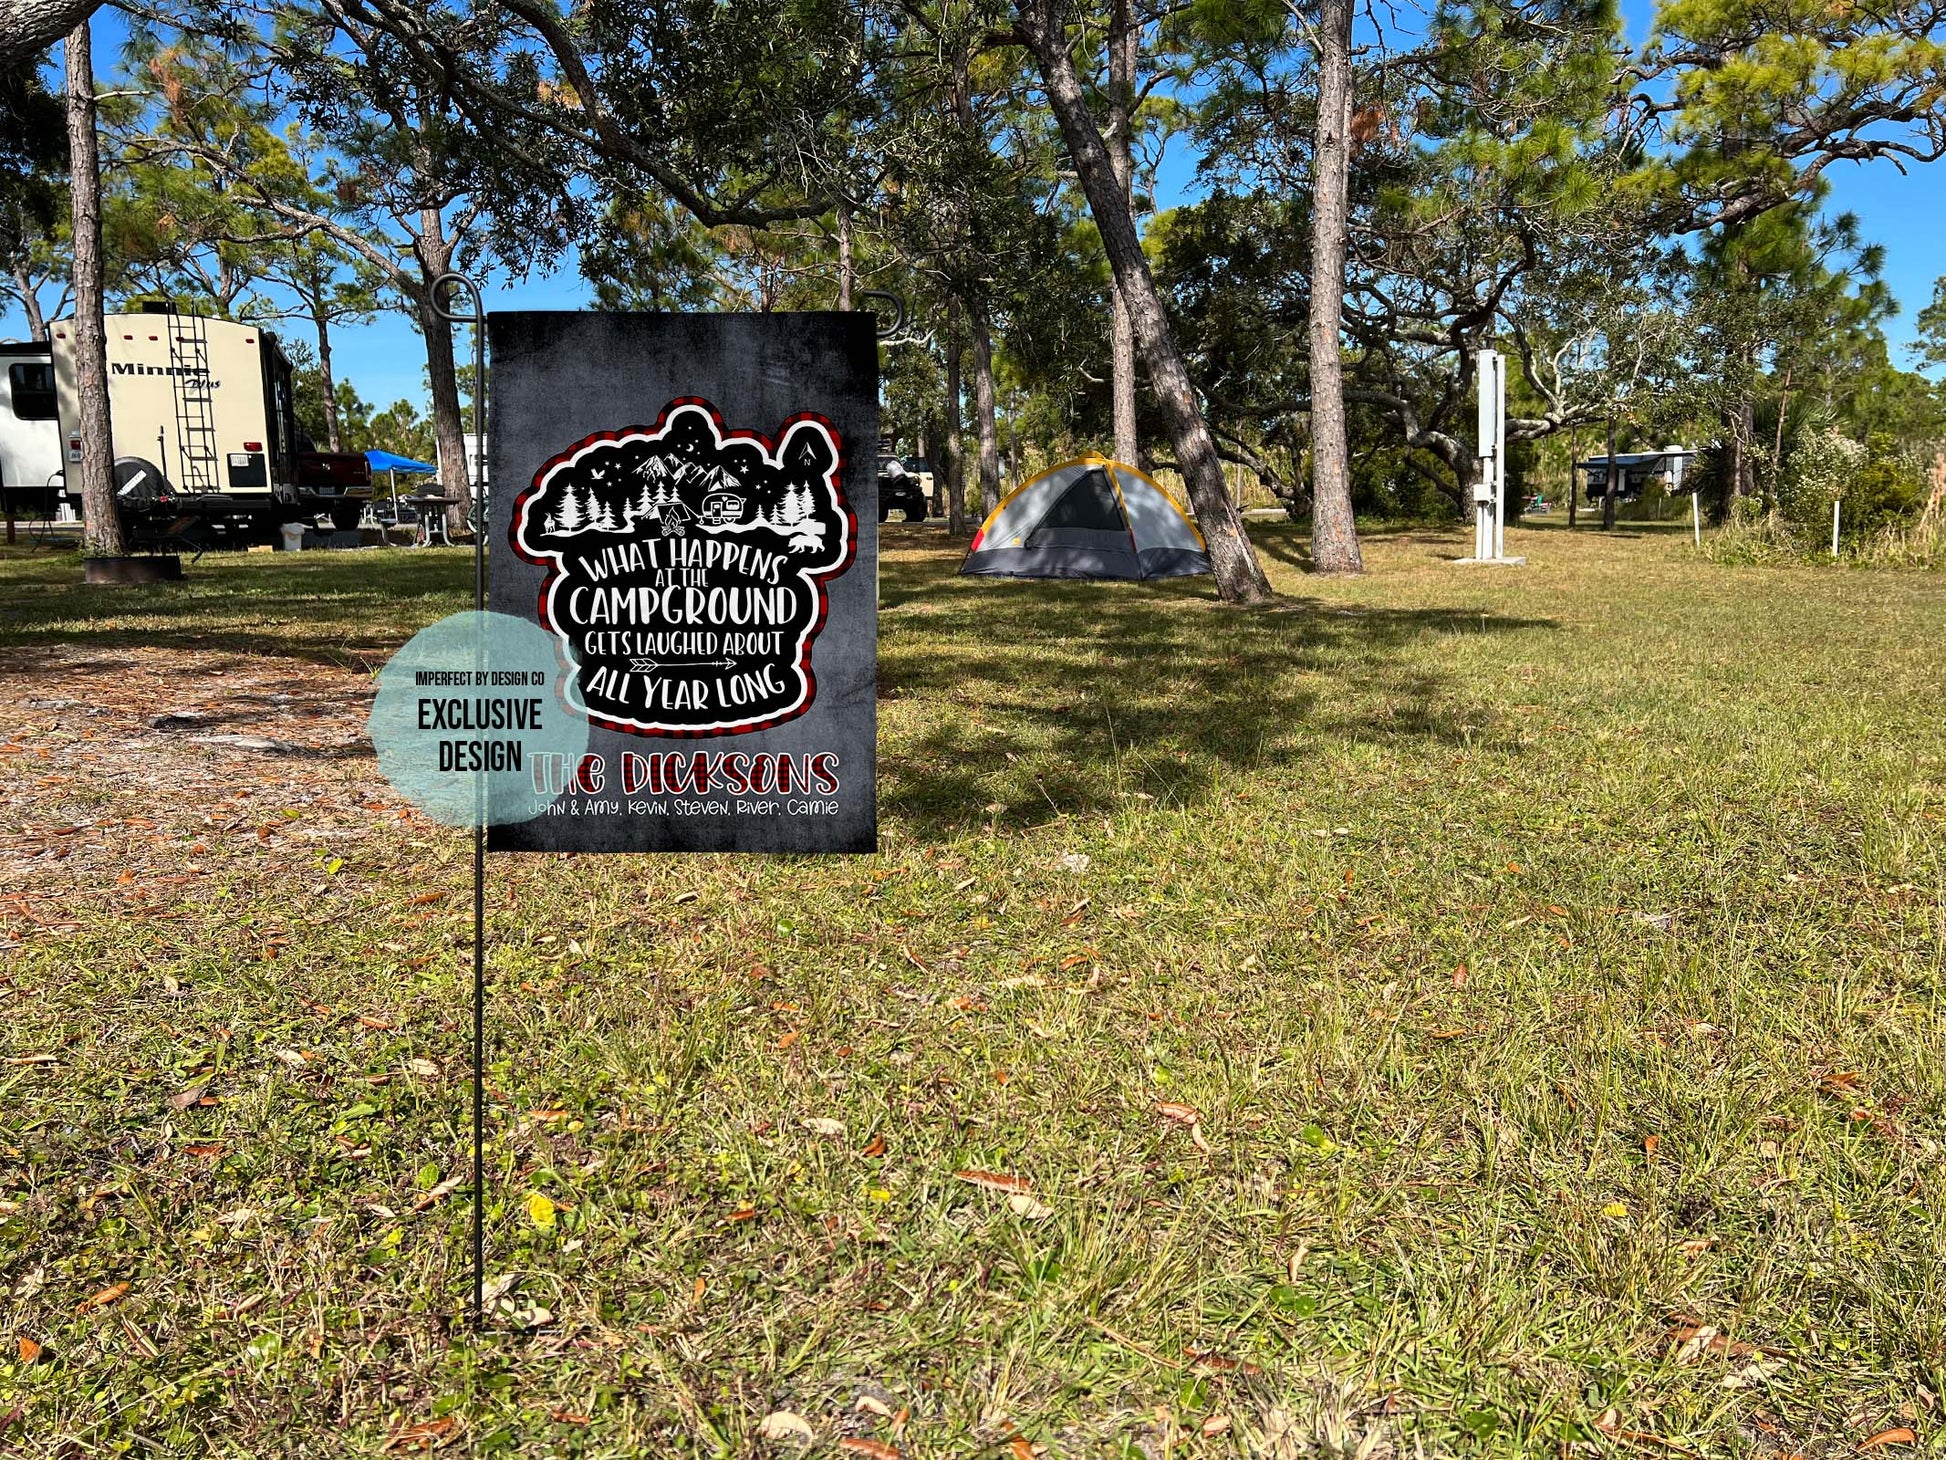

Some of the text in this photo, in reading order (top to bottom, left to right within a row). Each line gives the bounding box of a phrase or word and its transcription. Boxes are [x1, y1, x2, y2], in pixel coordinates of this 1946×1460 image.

[111, 363, 210, 376] Minnie
[578, 537, 788, 585] WHAT HAPPENS
[655, 567, 709, 588] AT THE
[569, 584, 797, 626] CAMPGROUND
[584, 630, 785, 656] GETS LAUGHED ABOUT
[586, 662, 786, 710] ALL YEAR LONG
[621, 750, 840, 796] DICKSONS
[570, 800, 580, 816] &
